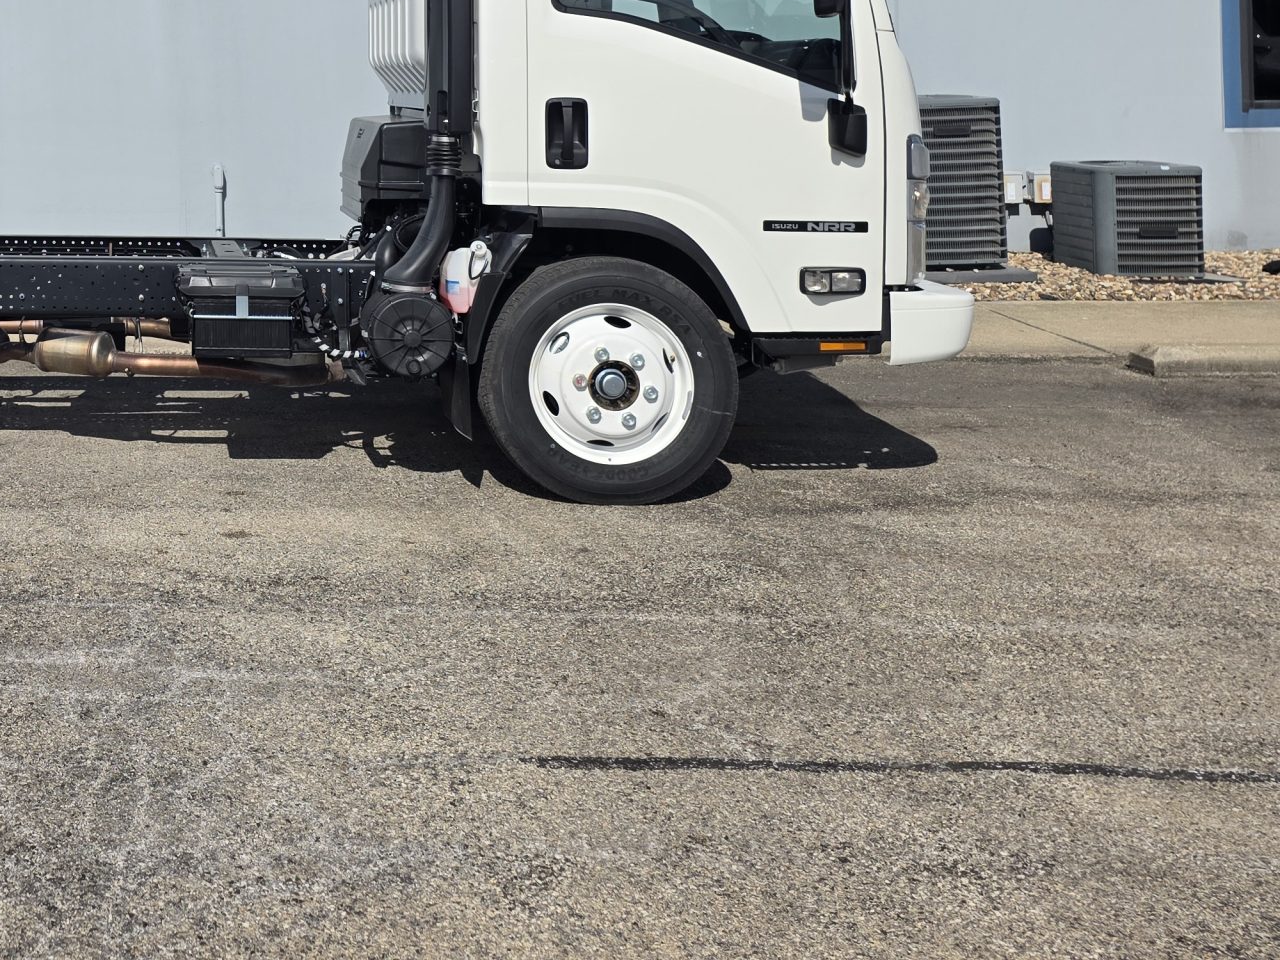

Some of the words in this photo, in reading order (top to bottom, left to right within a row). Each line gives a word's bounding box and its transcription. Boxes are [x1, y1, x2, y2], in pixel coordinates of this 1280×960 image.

[806, 222, 856, 232] NRR
[612, 288, 655, 307] MAX
[658, 304, 693, 336] RSA
